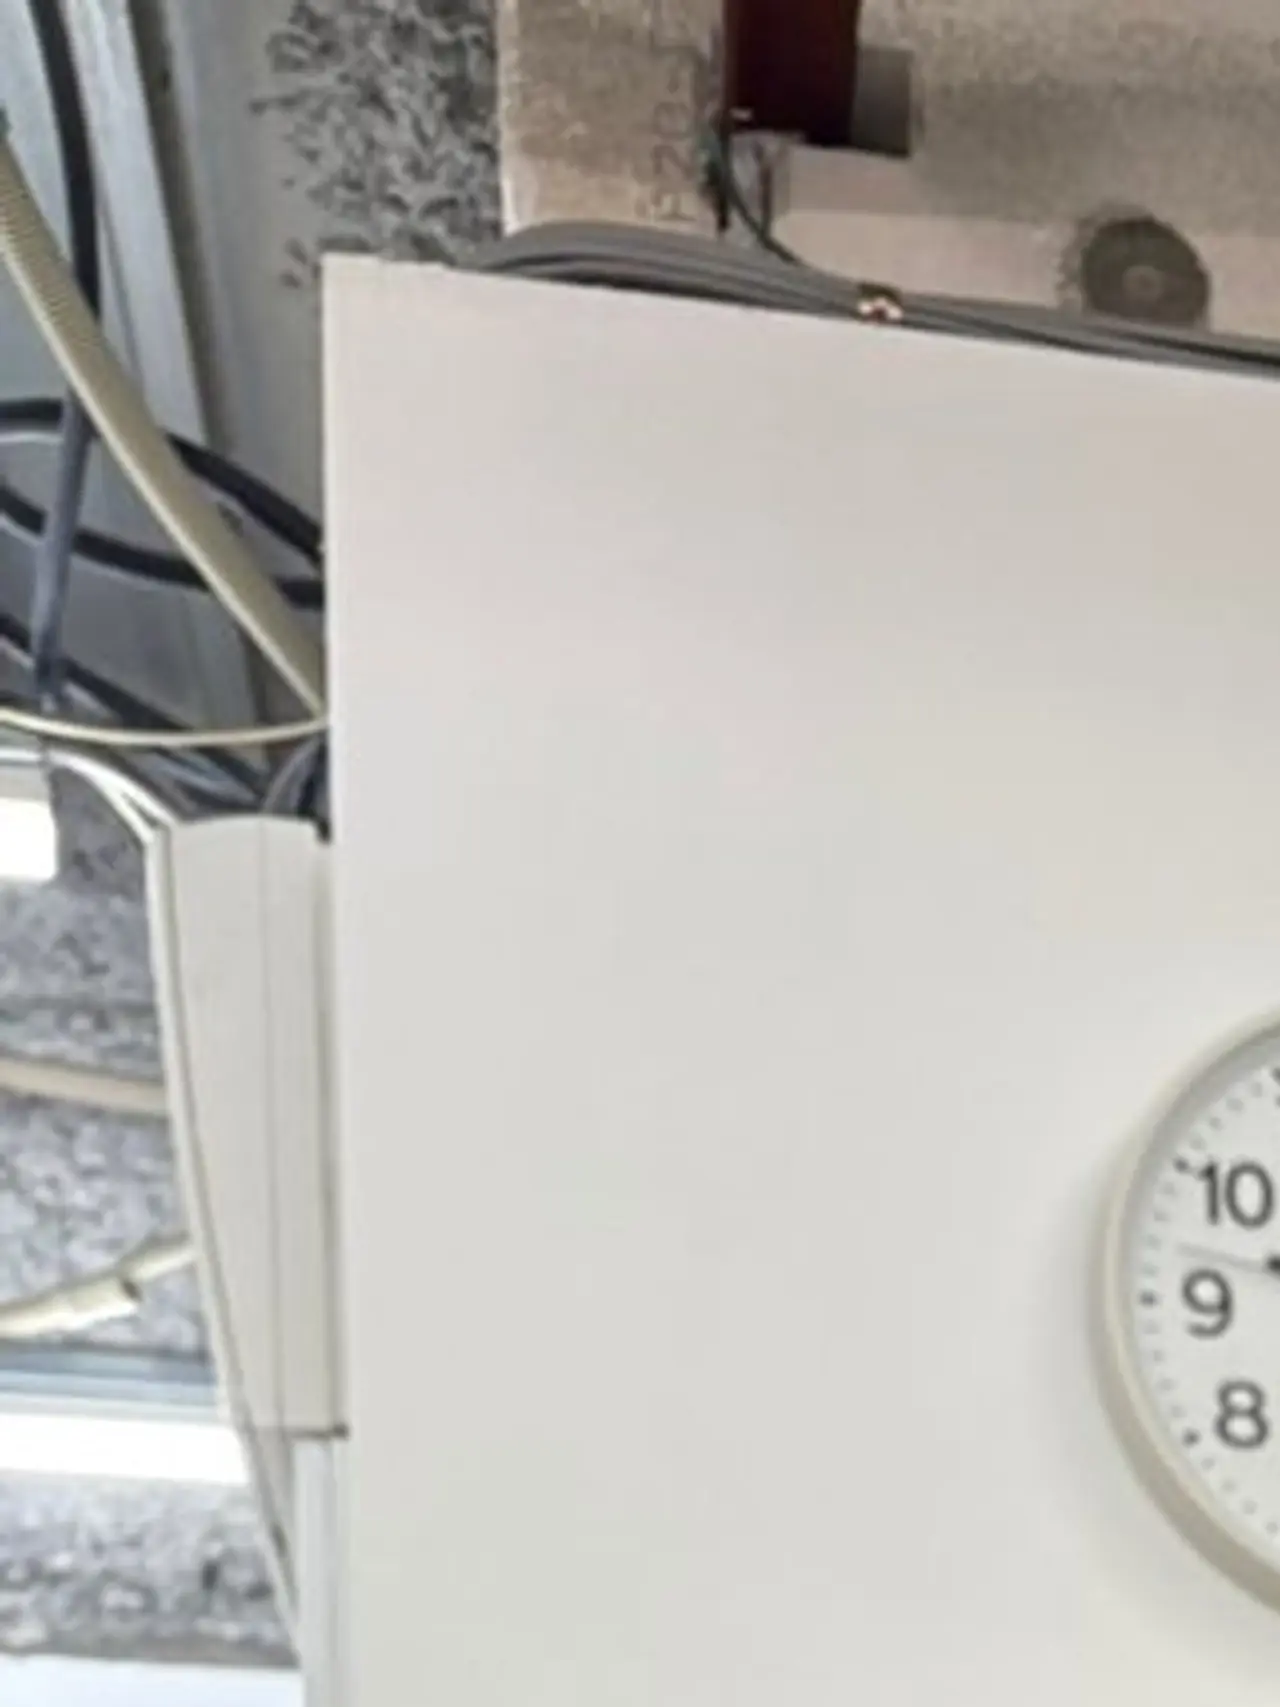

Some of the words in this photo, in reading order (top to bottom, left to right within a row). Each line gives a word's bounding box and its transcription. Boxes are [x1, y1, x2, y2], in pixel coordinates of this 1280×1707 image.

[1197, 1160, 1275, 1229] 10
[1181, 1267, 1234, 1338] 9
[1213, 1379, 1270, 1450] 8
